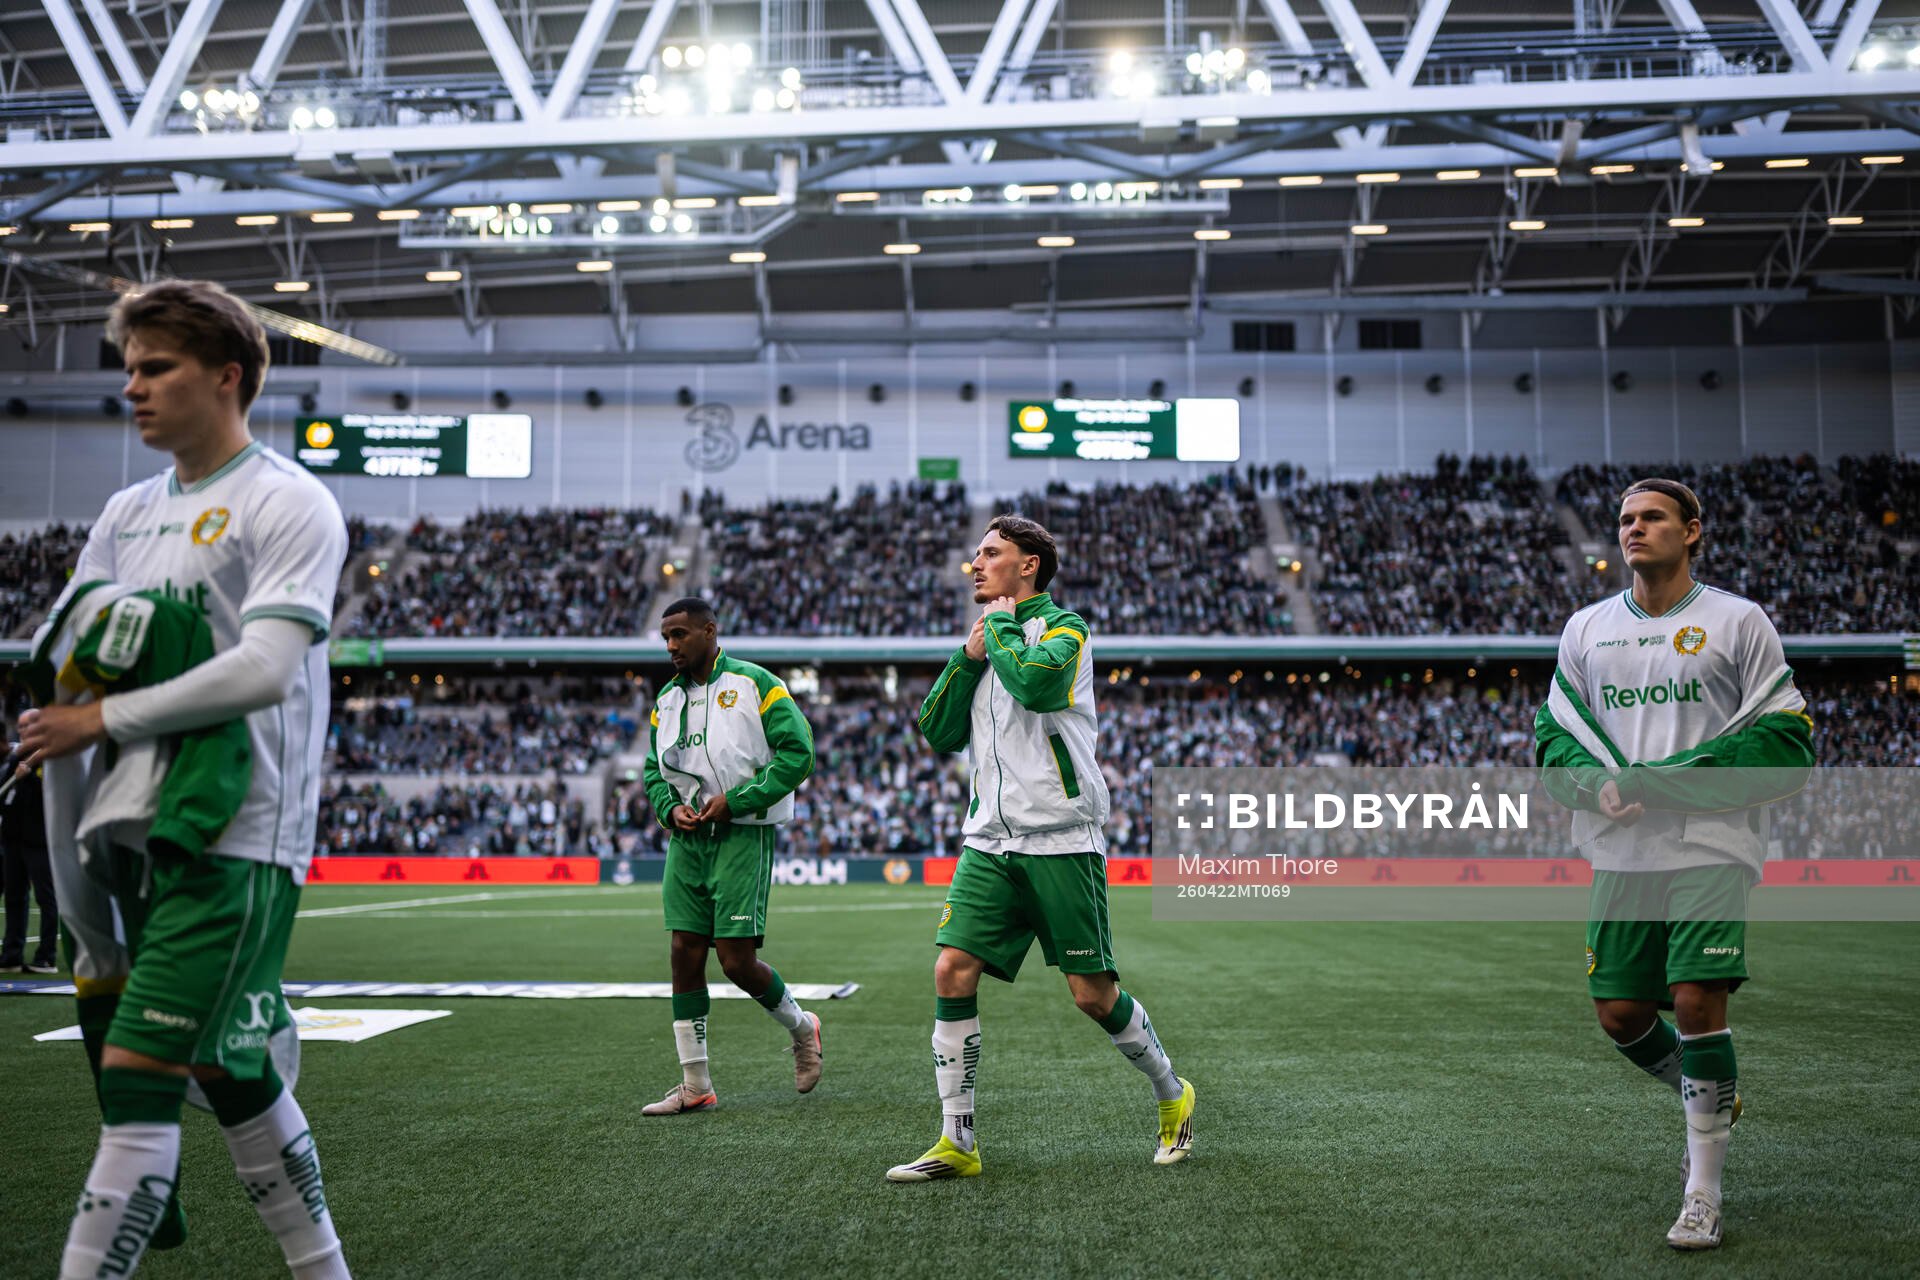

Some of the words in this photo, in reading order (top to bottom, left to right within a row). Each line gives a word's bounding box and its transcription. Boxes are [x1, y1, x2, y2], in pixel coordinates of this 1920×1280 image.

[746, 413, 871, 450] Arena
[1596, 640, 1621, 648] CRAFT
[1601, 677, 1703, 711] Revolut
[1703, 947, 1732, 955] CRAFT
